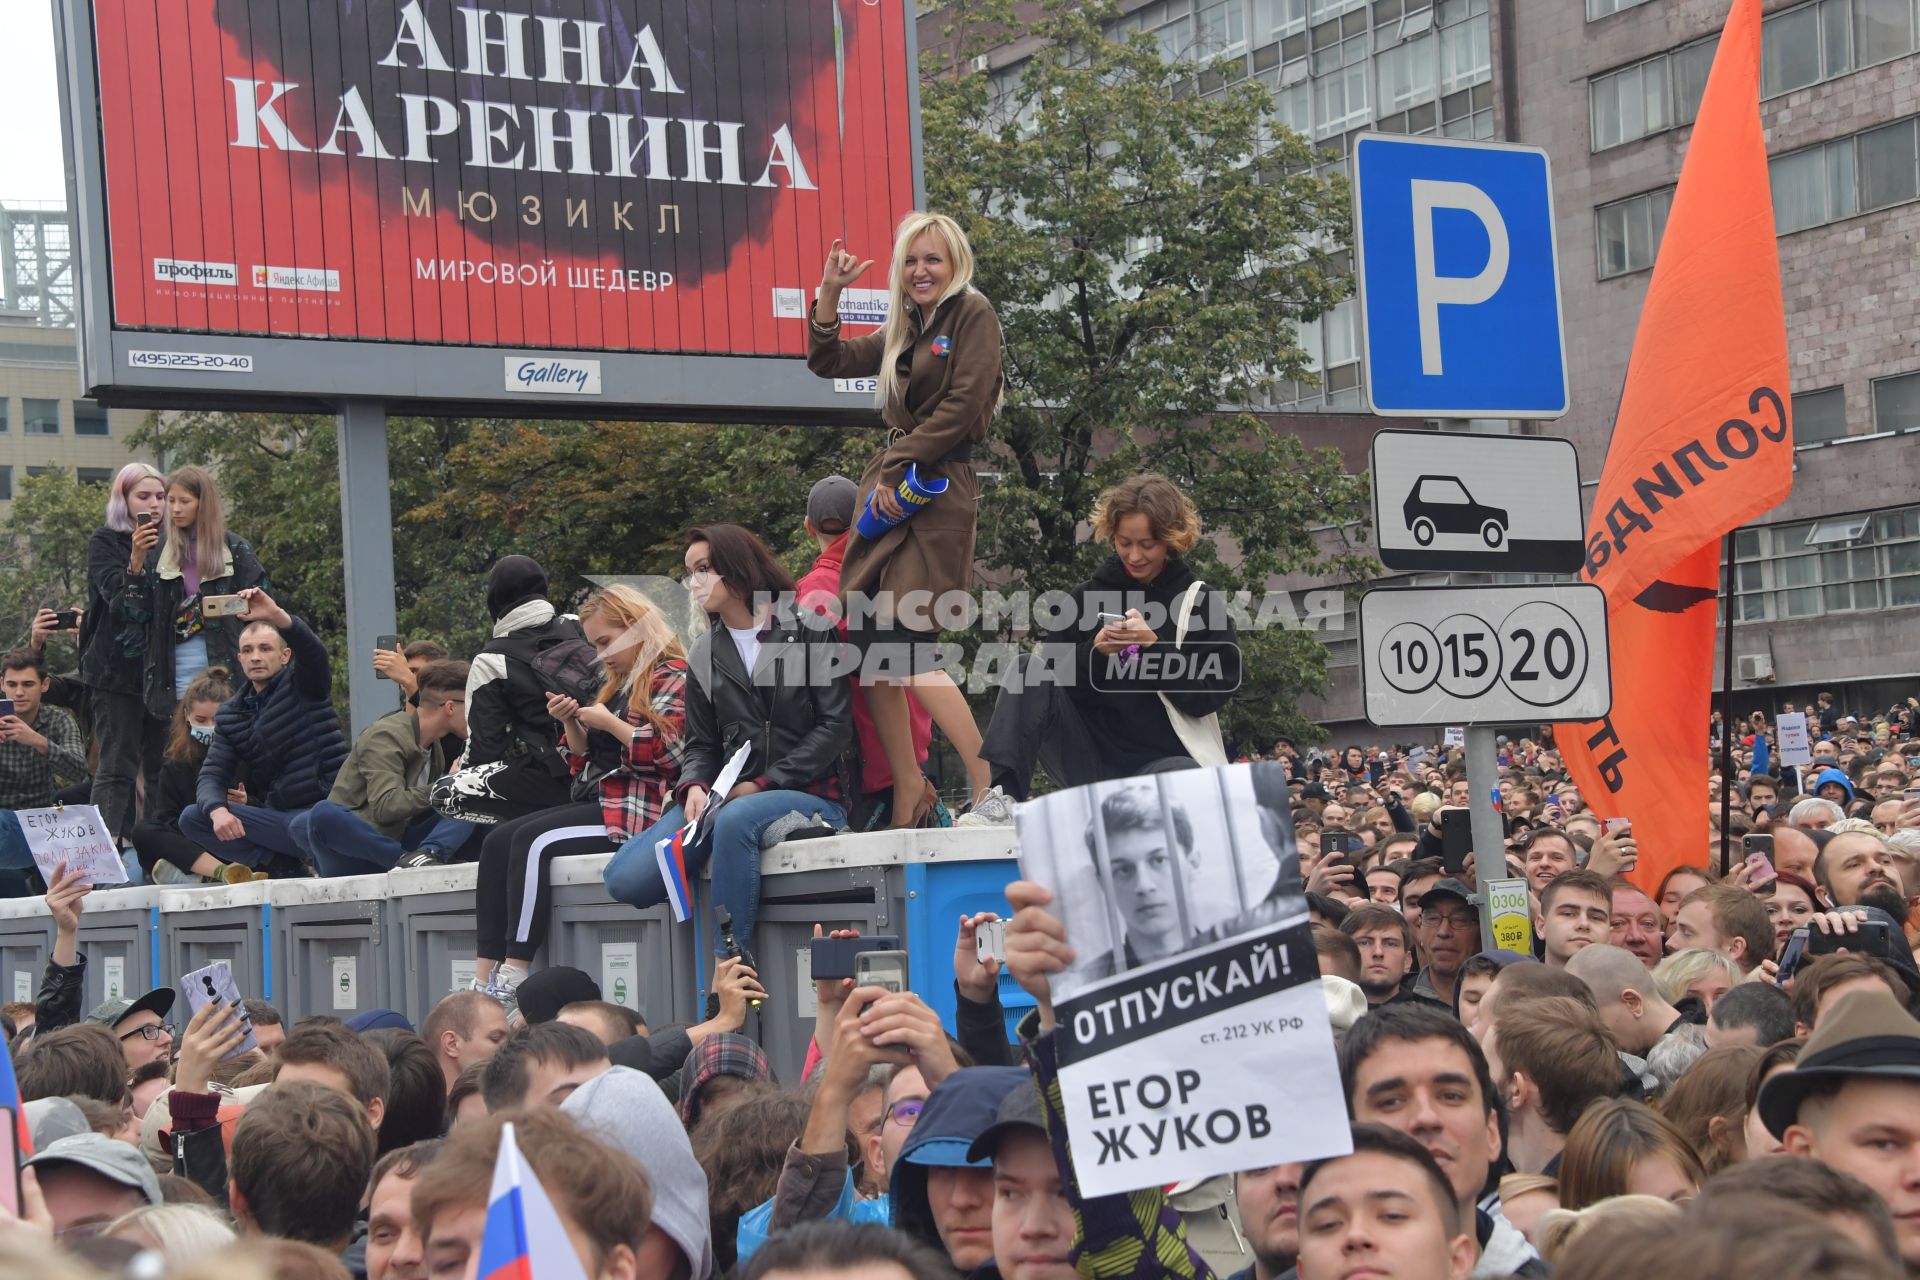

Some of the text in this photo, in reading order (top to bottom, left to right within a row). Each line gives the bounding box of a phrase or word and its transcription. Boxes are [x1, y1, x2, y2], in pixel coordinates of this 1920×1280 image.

[377, 0, 685, 94] АННА
[226, 77, 819, 190] КАРЕНИНА
[402, 186, 681, 234] МЮЗИКЛ
[157, 264, 234, 280] профиль
[273, 272, 338, 289] Яндекс Афиша
[416, 258, 674, 292] МИРОВОЙ ШЕДЕВР
[1411, 179, 1510, 376] P
[156, 288, 273, 304] ИНФОРМАЦИОННЫЕ
[839, 299, 889, 312] omantika
[132, 353, 249, 369] (495)225-20-40
[517, 362, 588, 392] Gallery
[1390, 627, 1576, 682] 10 15 20
[27, 813, 58, 828] ЕГОР
[45, 824, 96, 842] ЖУКОВ
[1492, 894, 1525, 909] 0306
[1074, 942, 1292, 1045] ОТПУСКАЙ!
[1200, 1016, 1304, 1045] ст. 212 УК РФ
[1087, 1068, 1201, 1119] ЕГОР
[1092, 1103, 1272, 1166] ЖУКОВ
